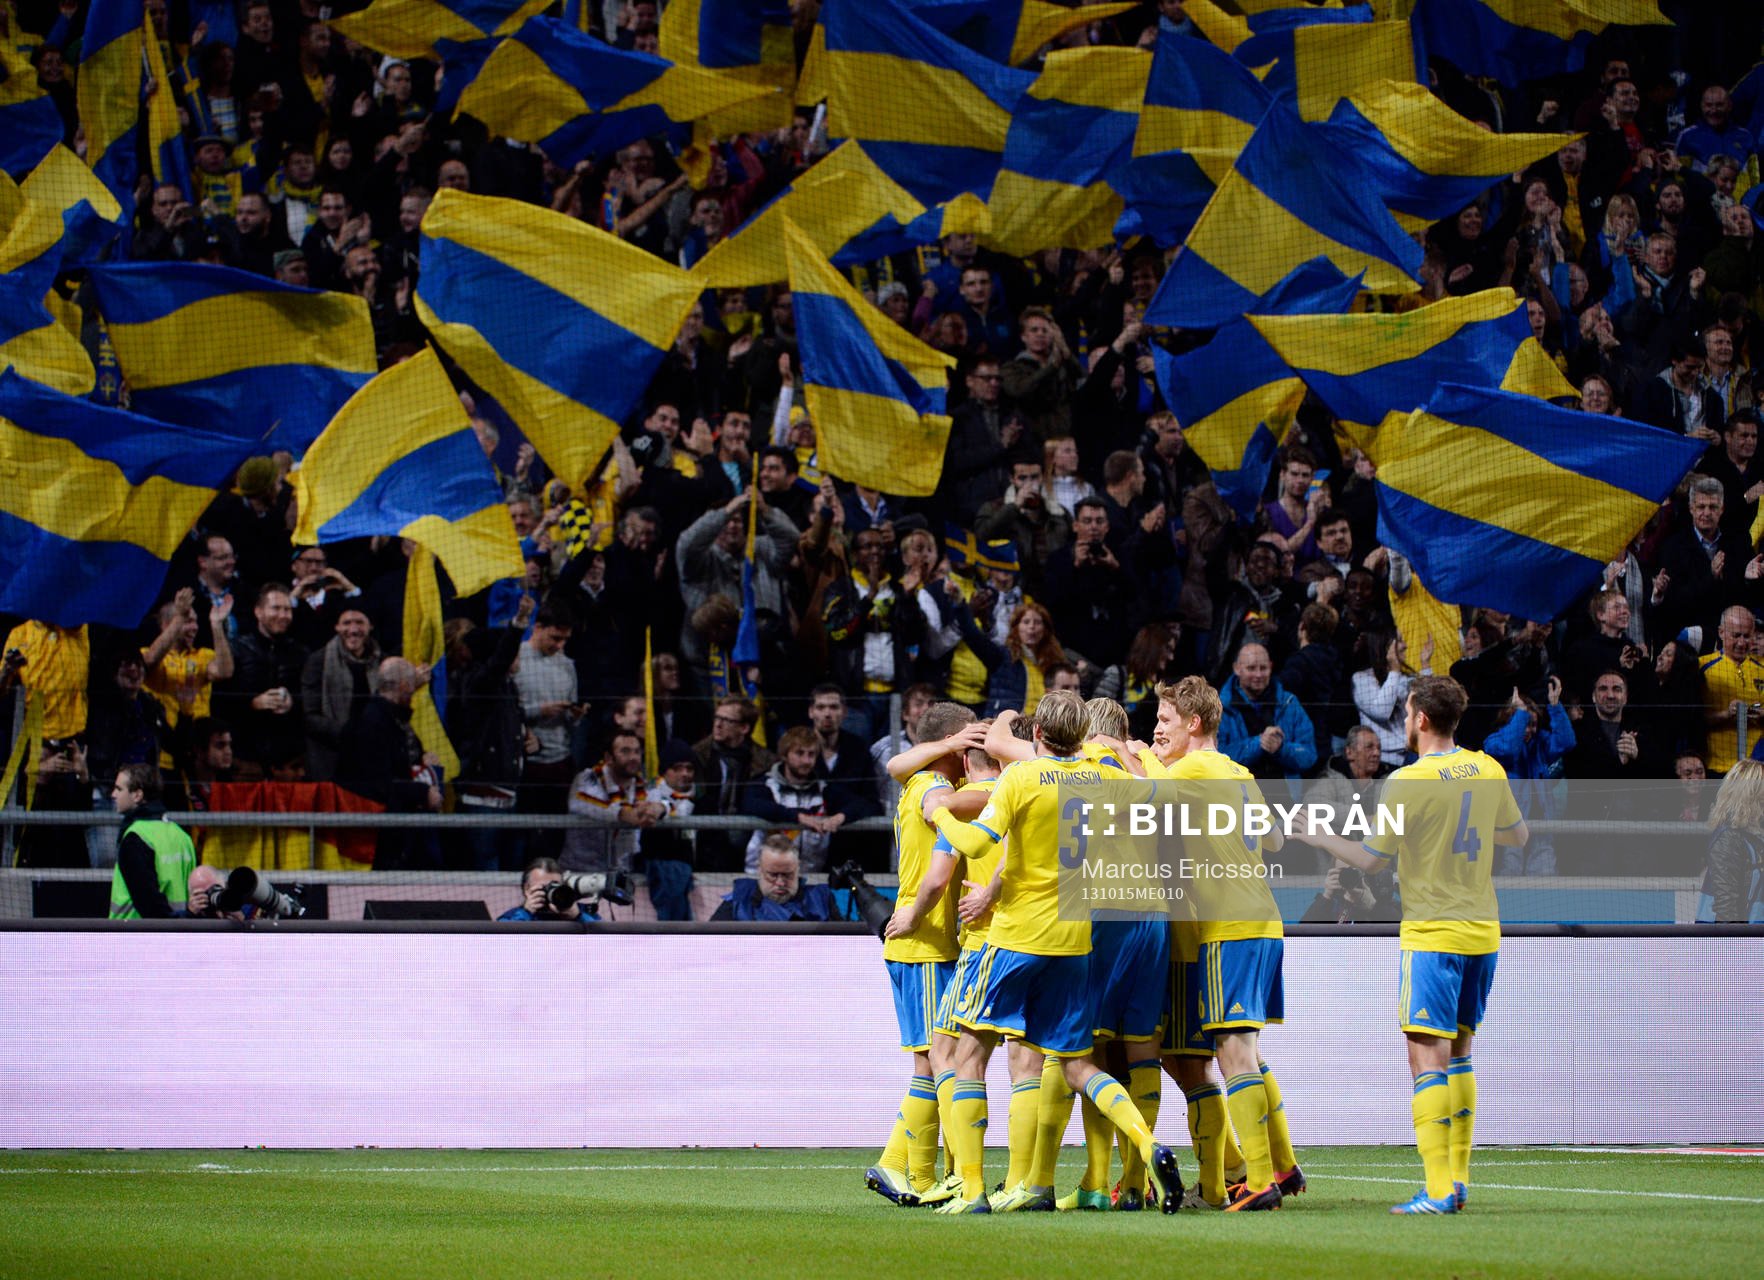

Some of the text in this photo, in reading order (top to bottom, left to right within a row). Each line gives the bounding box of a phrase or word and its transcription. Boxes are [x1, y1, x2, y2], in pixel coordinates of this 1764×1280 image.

[1039, 770, 1103, 786] ANTONSSON
[1438, 762, 1481, 782] NILSSON
[1058, 796, 1089, 870] 3
[1452, 790, 1482, 863] 4
[957, 984, 973, 1013] 3
